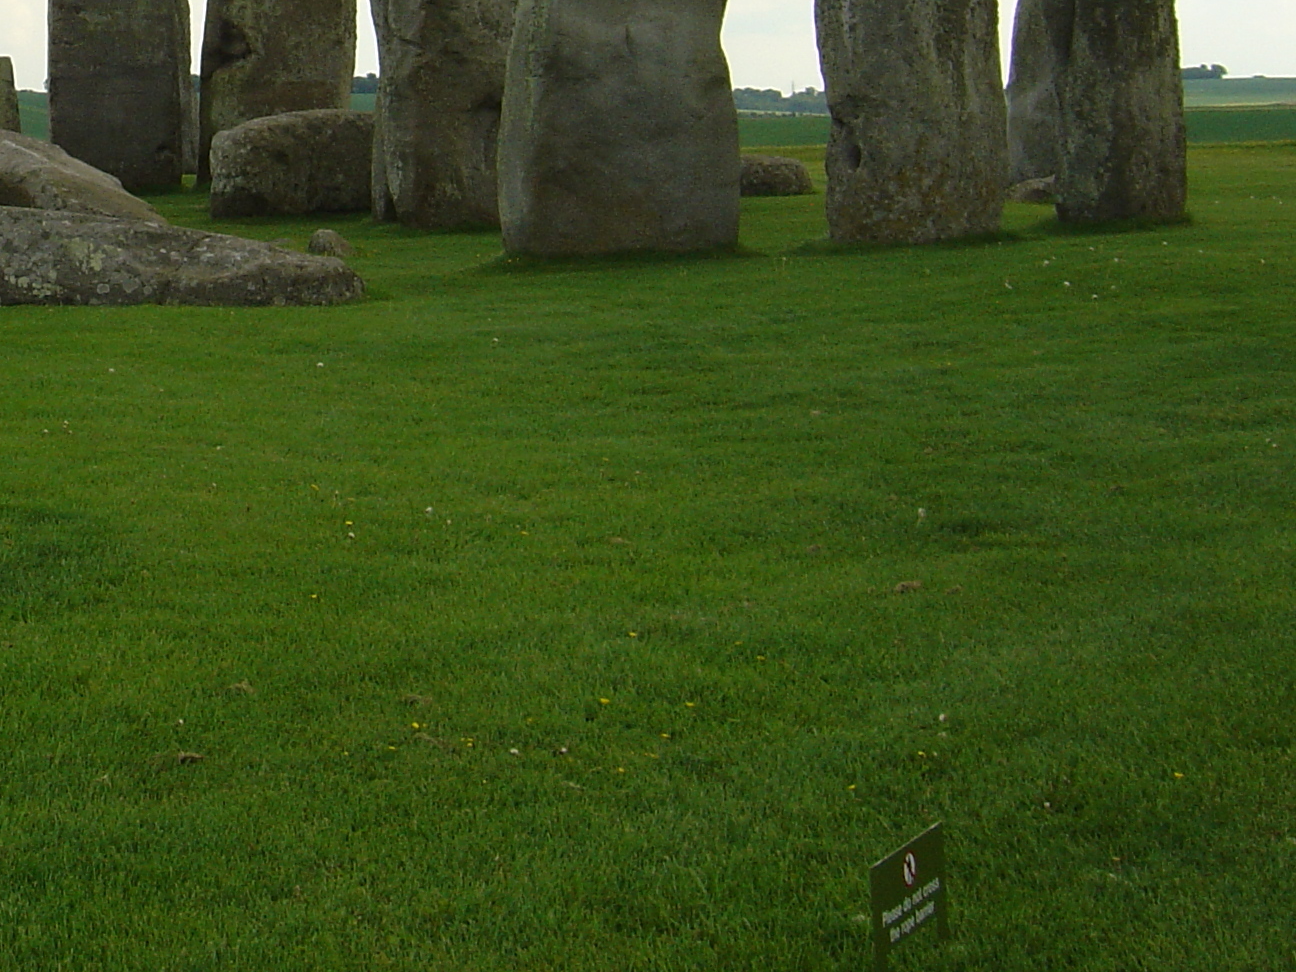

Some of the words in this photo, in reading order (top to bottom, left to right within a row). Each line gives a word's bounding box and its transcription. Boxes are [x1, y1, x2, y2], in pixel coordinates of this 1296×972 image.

[882, 904, 903, 928] Please
[903, 896, 912, 912] do
[912, 887, 923, 905] not
